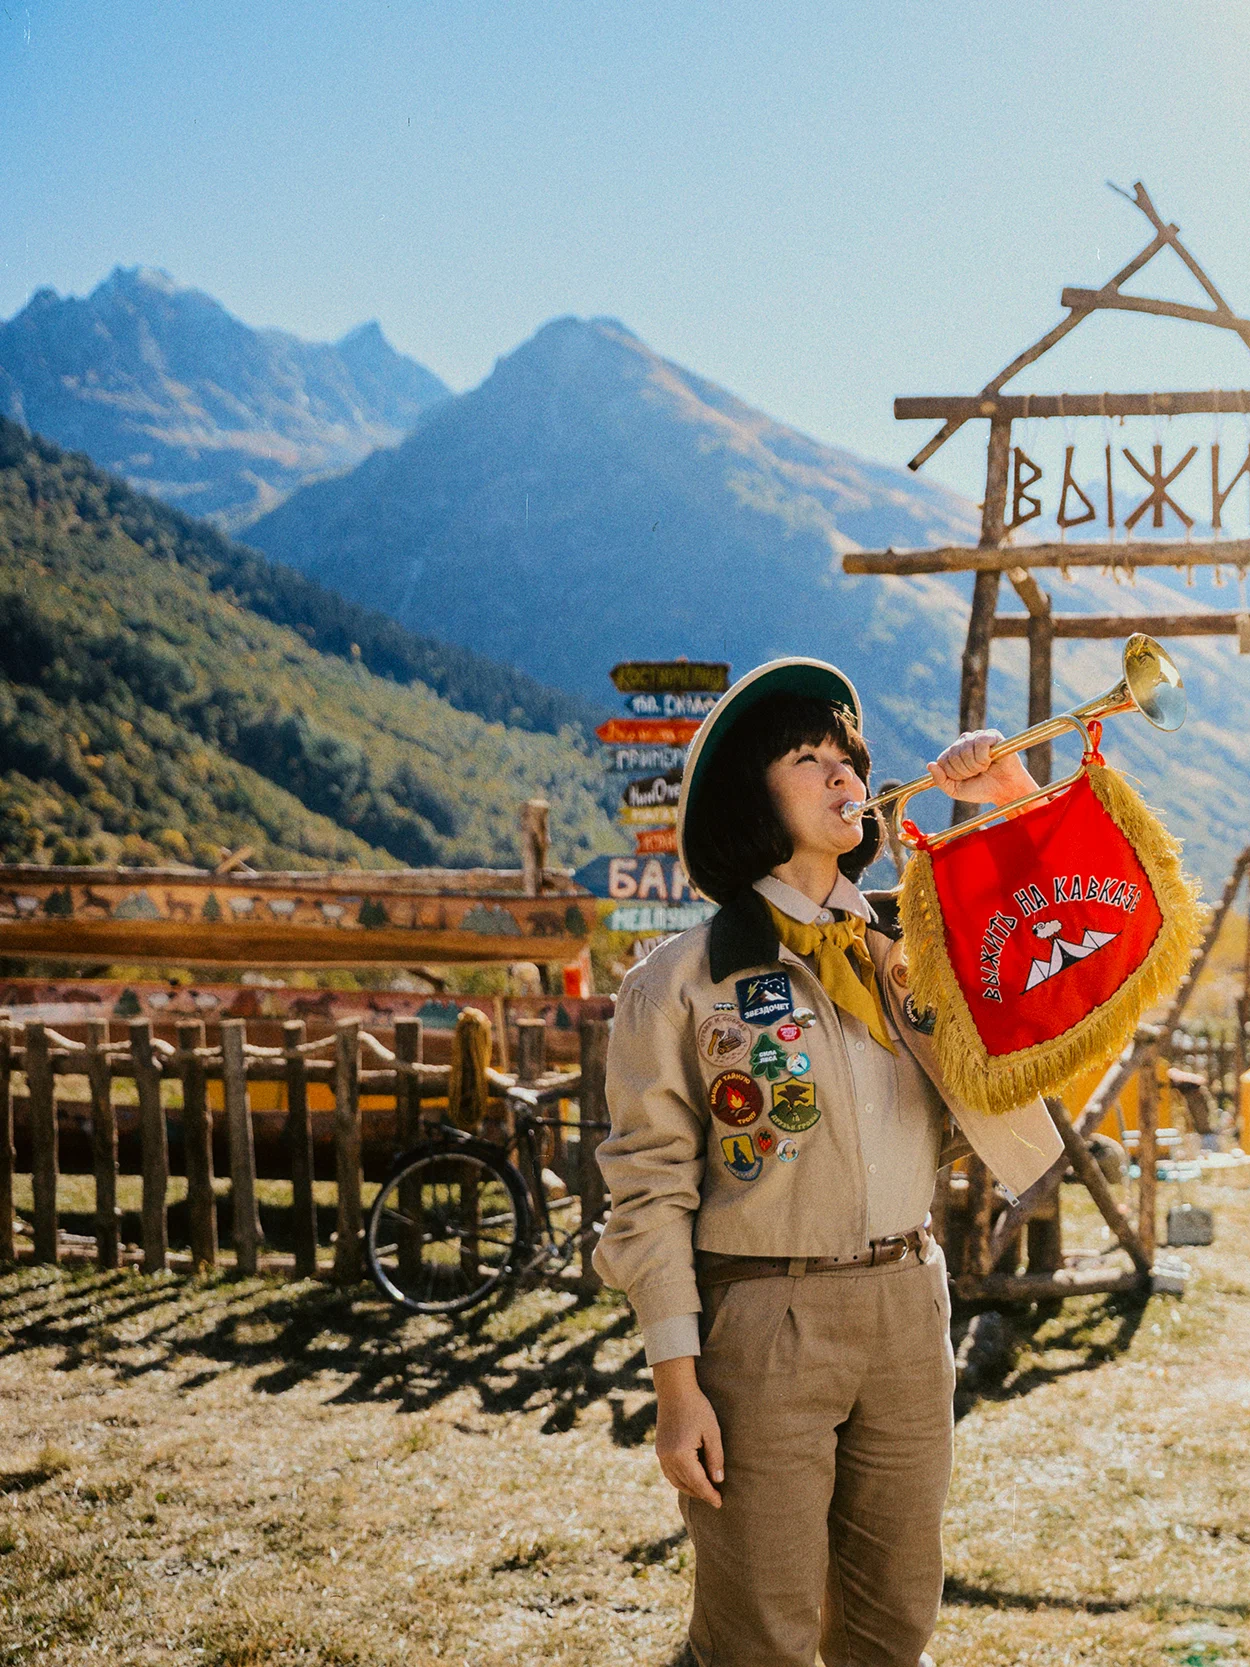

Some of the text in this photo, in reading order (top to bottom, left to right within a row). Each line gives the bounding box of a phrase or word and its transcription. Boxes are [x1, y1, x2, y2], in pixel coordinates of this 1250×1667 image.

[616, 750, 687, 769] ГРИМЕР
[609, 858, 700, 899] БАН
[981, 875, 1141, 1003] ВЫЖИТЬ НА КАВКАЗЕ
[744, 1002, 790, 1019] ЗВЕЗДОЧЕТ
[759, 1050, 777, 1058] СИЛА
[711, 1072, 751, 1105] НАШЕЛ ТАЙНУЮ
[737, 1111, 757, 1125] ТРОПУ
